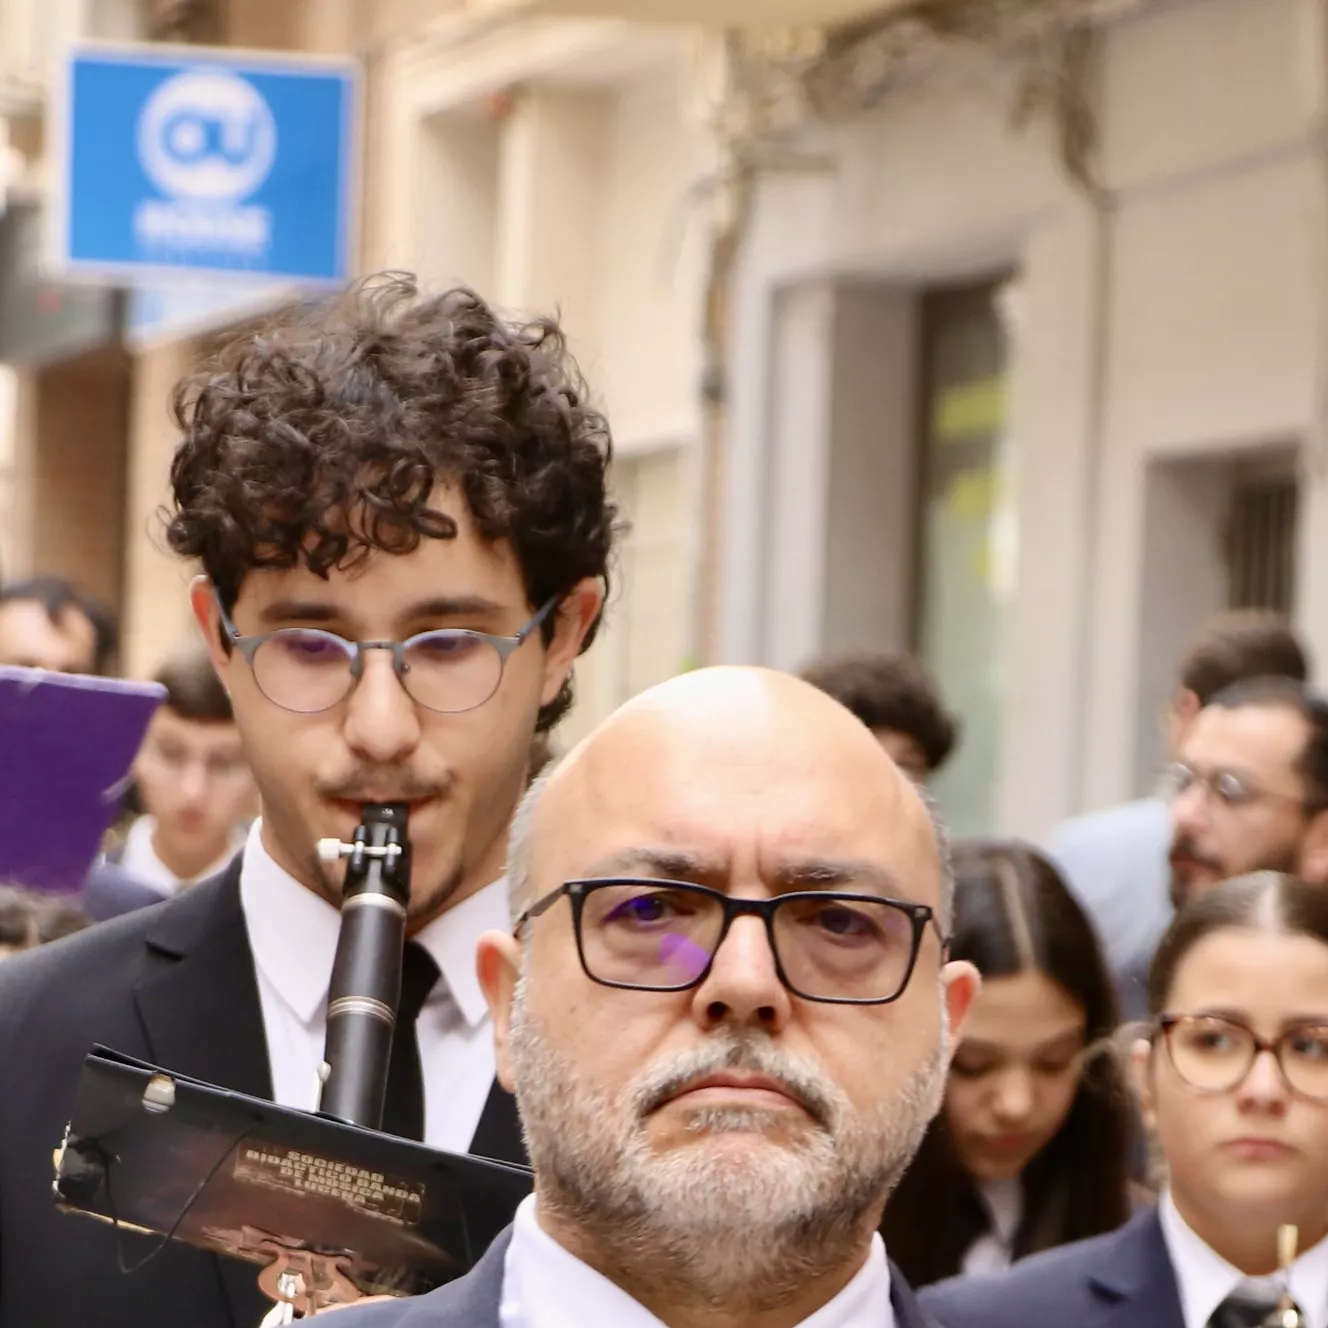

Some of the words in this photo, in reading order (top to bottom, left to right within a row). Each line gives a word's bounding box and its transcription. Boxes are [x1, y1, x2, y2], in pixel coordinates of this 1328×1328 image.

[280, 1166, 305, 1178] DE
[287, 1150, 384, 1183] SOCIEDAD
[294, 1178, 367, 1205] LUCENA
[357, 1178, 421, 1203] BANDA
